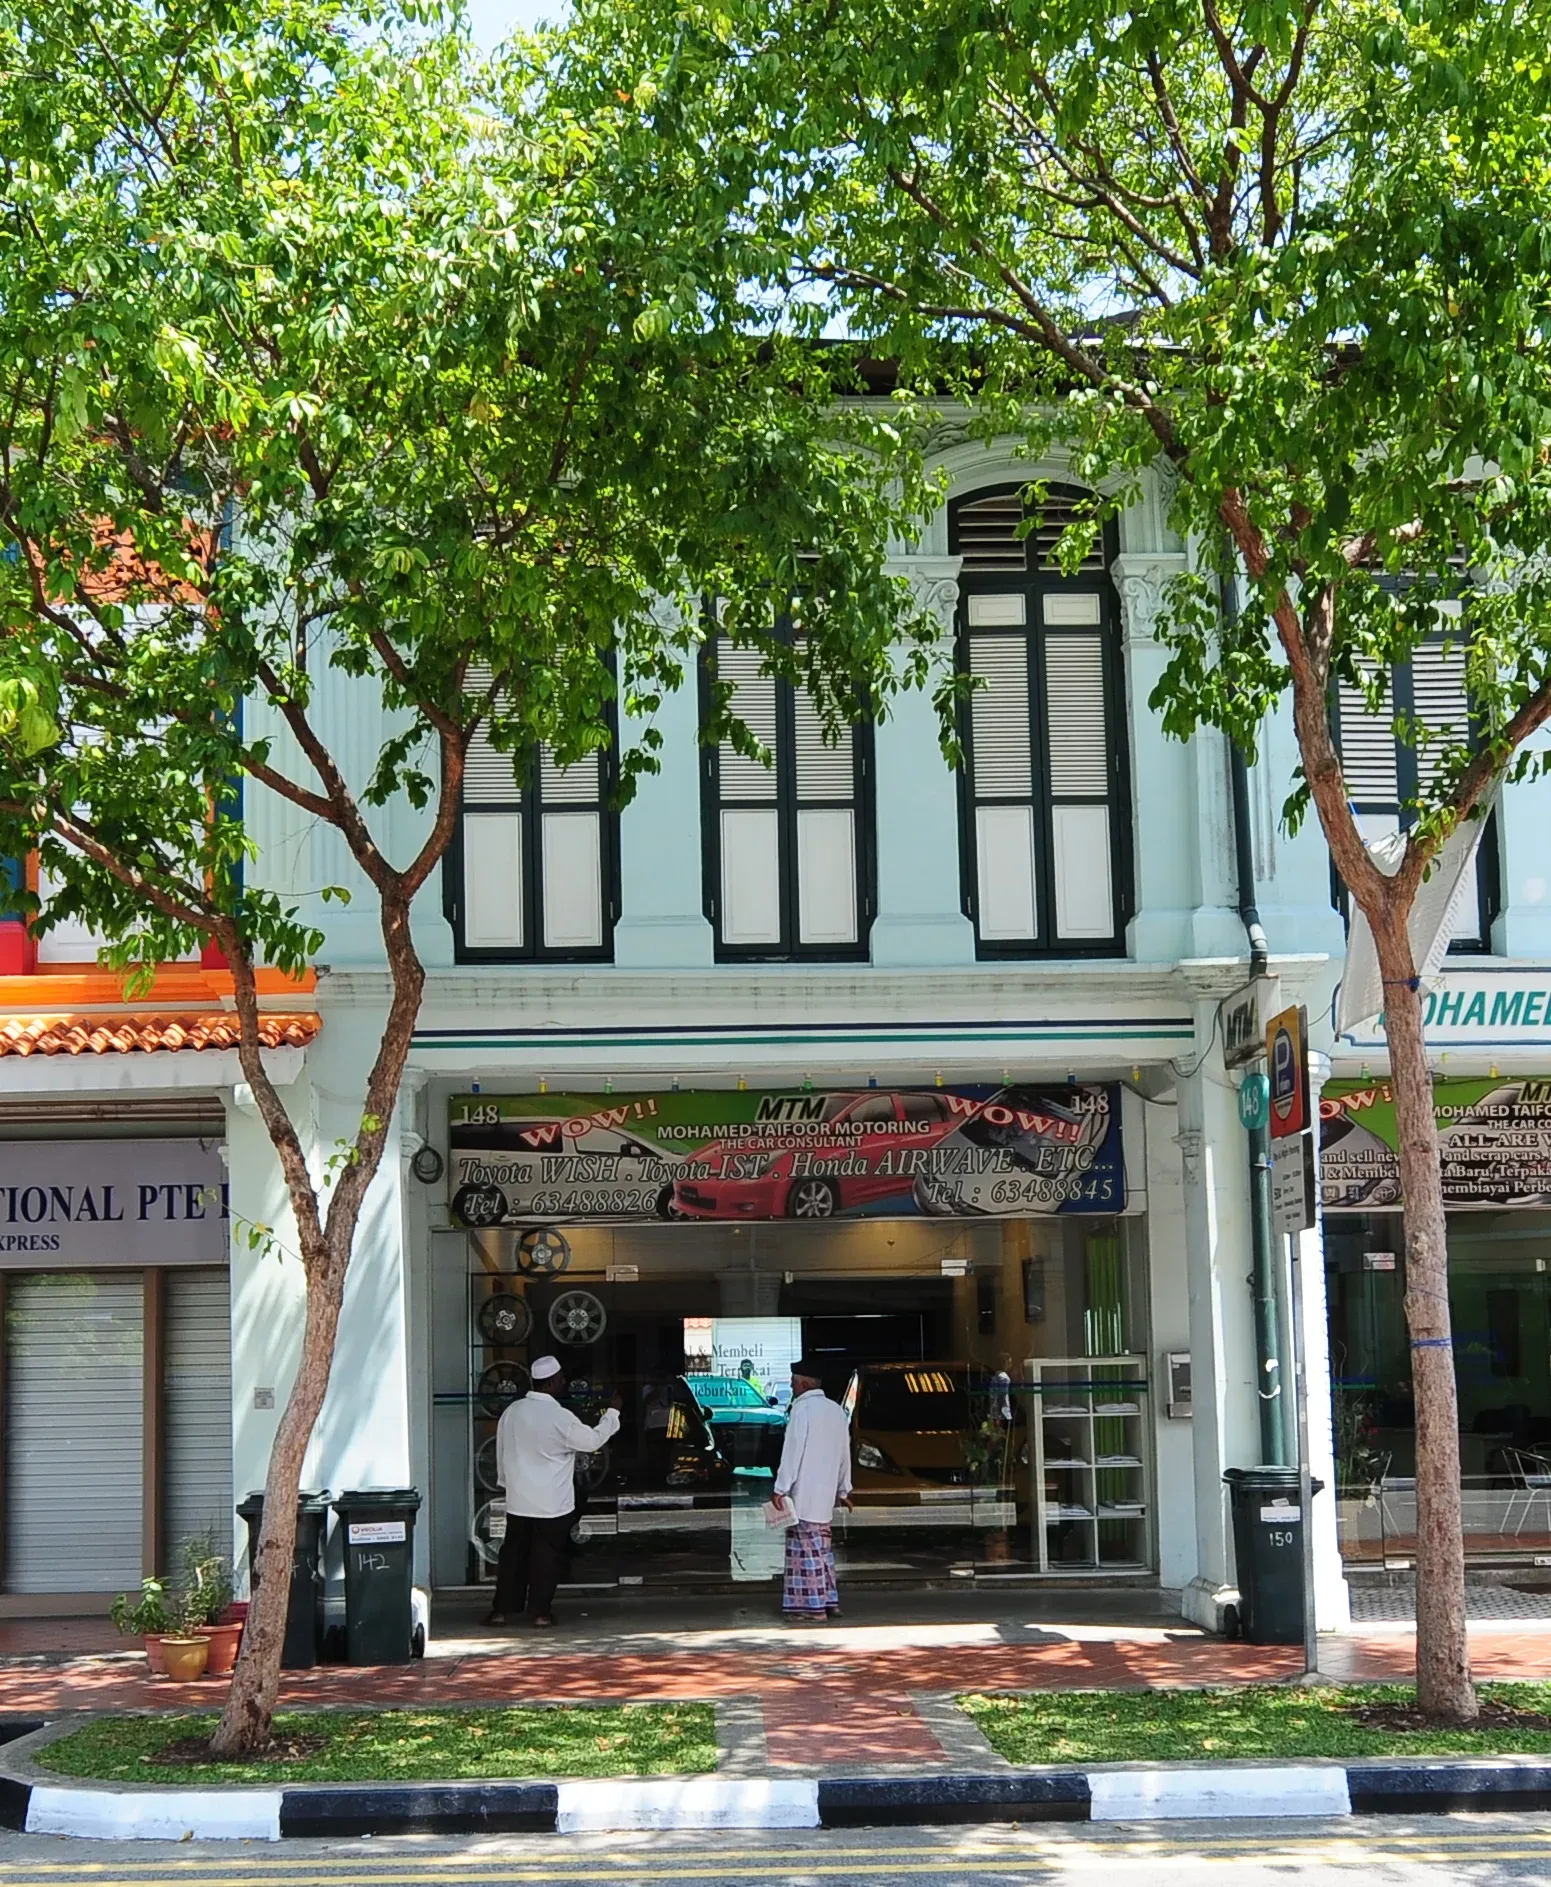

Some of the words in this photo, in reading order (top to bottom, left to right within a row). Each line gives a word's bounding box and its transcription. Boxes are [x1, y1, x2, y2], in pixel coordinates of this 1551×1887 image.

[757, 1097, 827, 1121] MTM
[1072, 1094, 1109, 1115] 148
[1242, 1086, 1259, 1118] 148
[1320, 1086, 1392, 1119] OW!
[462, 1104, 498, 1125] 148
[519, 1098, 659, 1148] WOW!!
[944, 1094, 1083, 1142] WOW!!
[1488, 1119, 1509, 1129] THE
[1511, 1119, 1535, 1129] CAR
[657, 1124, 751, 1140] MOHAMED
[754, 1122, 831, 1137] TAIFOOR
[834, 1120, 930, 1135] MOTORING
[1449, 1134, 1493, 1148] ALL
[1497, 1133, 1539, 1147] ARE
[719, 1138, 745, 1150] THE
[748, 1138, 775, 1149] CAR
[777, 1135, 863, 1149] CONSULTANT
[1349, 1148, 1373, 1163] sell
[1473, 1151, 1511, 1163] scrap
[459, 1158, 532, 1188] Toyota
[540, 1155, 621, 1184] WISH
[638, 1155, 711, 1187] Toyota
[717, 1153, 770, 1180] IST
[788, 1152, 868, 1179] Honda
[873, 1147, 1015, 1177] AIRWAVE
[1036, 1145, 1114, 1172] ETC...
[465, 1193, 500, 1216] Tel
[531, 1187, 657, 1214] 63488826
[927, 1181, 962, 1204] Tel
[990, 1178, 1114, 1202] 63488845
[0, 1184, 124, 1223] IONAL
[137, 1183, 206, 1221] PTE
[718, 1362, 771, 1381] Terpkai
[1269, 1531, 1293, 1547] 150
[358, 1553, 390, 1572] 142
